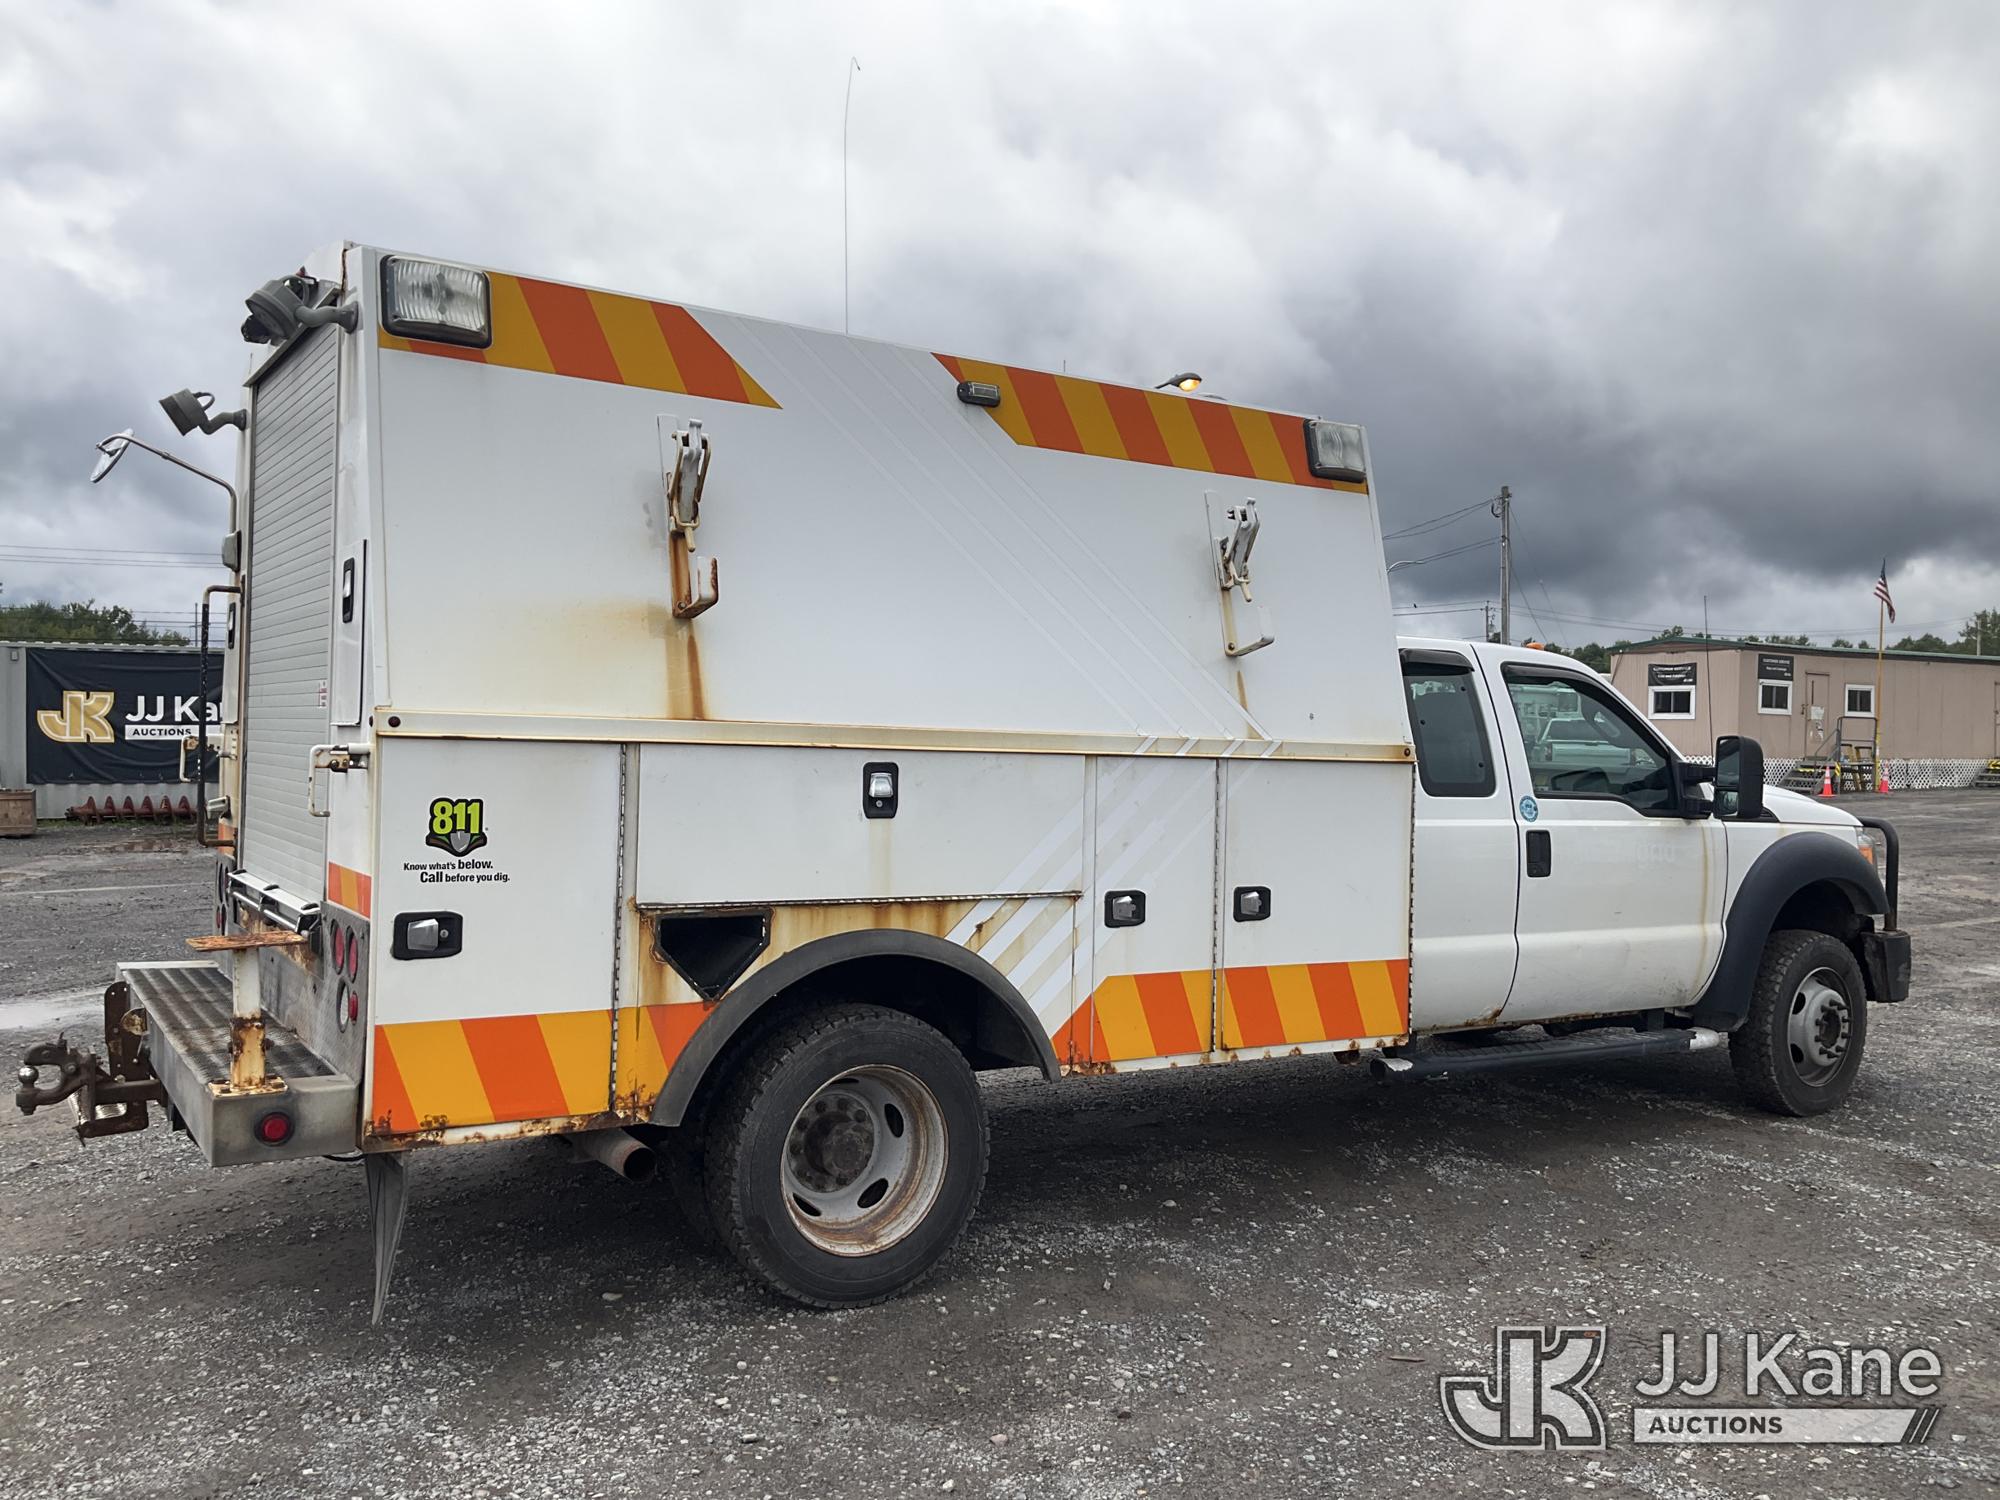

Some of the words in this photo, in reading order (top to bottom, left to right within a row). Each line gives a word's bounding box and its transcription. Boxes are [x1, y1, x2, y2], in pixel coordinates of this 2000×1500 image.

[37, 690, 115, 743] JK
[125, 695, 165, 722] JJ
[174, 695, 222, 722] Ka
[132, 728, 192, 737] AUCTIONS
[431, 799, 482, 834] 811
[403, 862, 427, 871] Know
[428, 862, 456, 870] what's
[458, 859, 493, 869] below.
[420, 871, 443, 883] Call
[445, 873, 475, 882] before
[476, 875, 492, 883] you
[493, 872, 510, 882] dig.
